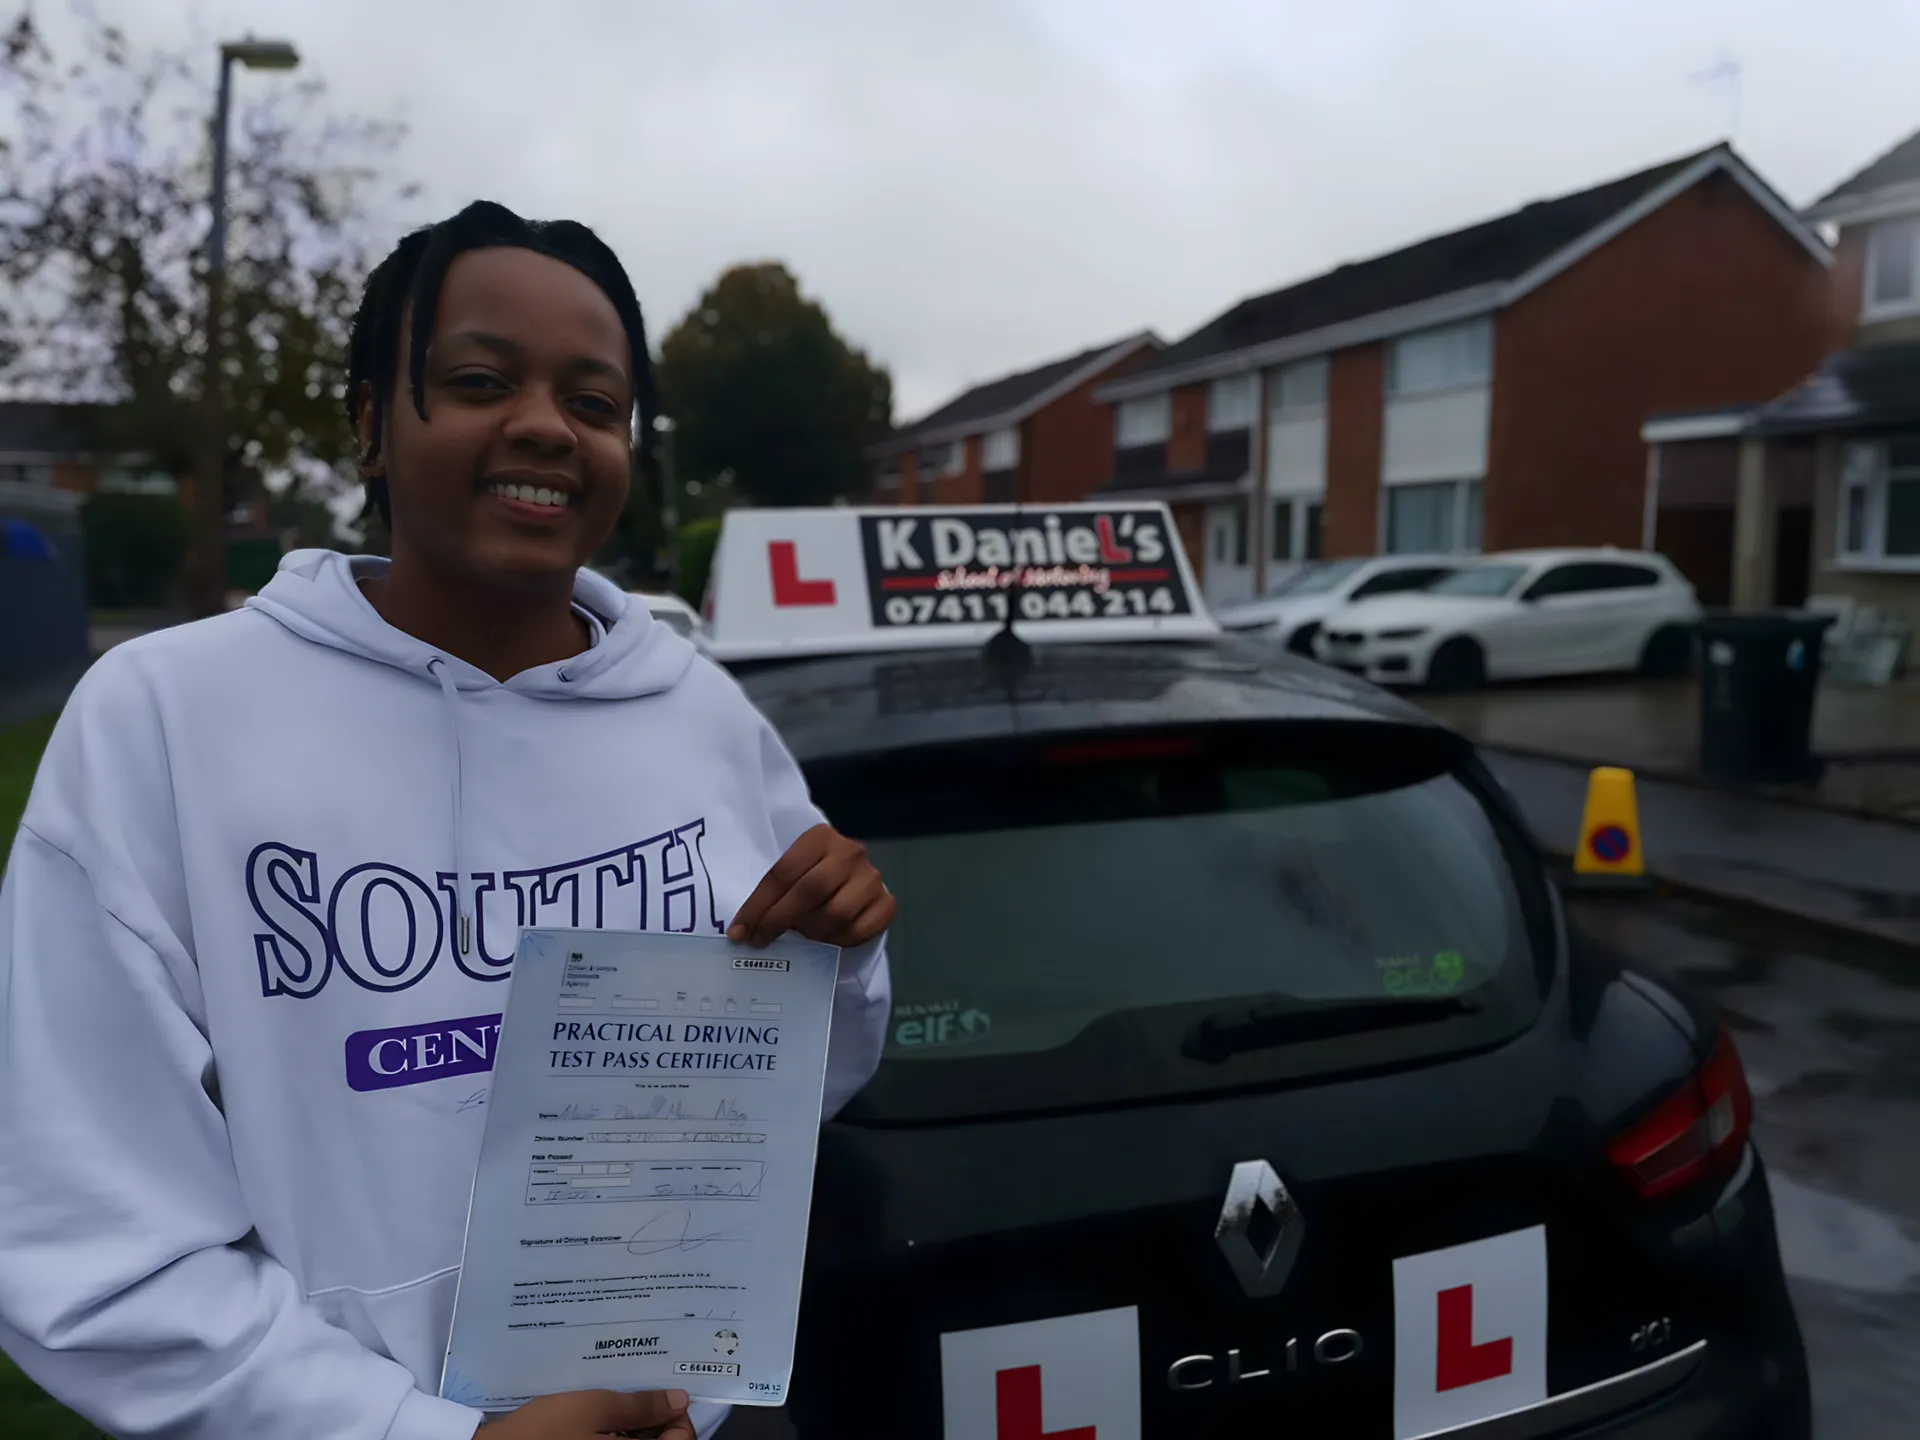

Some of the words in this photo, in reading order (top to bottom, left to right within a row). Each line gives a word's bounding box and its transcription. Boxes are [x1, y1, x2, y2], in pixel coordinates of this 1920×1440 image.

[877, 519, 923, 569] K
[768, 540, 836, 607] L
[885, 592, 1008, 624] 07411
[1021, 588, 1096, 617] 044
[1104, 586, 1175, 613] 214
[246, 818, 724, 998] SOUTH
[552, 1022, 675, 1042] PRACTICAL
[683, 1024, 779, 1045] DRIVING
[895, 1013, 956, 1046] elf
[549, 1051, 596, 1068] TEST
[602, 1051, 650, 1069] PASS
[656, 1052, 777, 1070] CERTIFICATE
[595, 1337, 660, 1350] IMPORTANT
[1167, 1328, 1363, 1390] CLIO
[1437, 1284, 1513, 1392] L
[995, 1365, 1096, 1440] L
